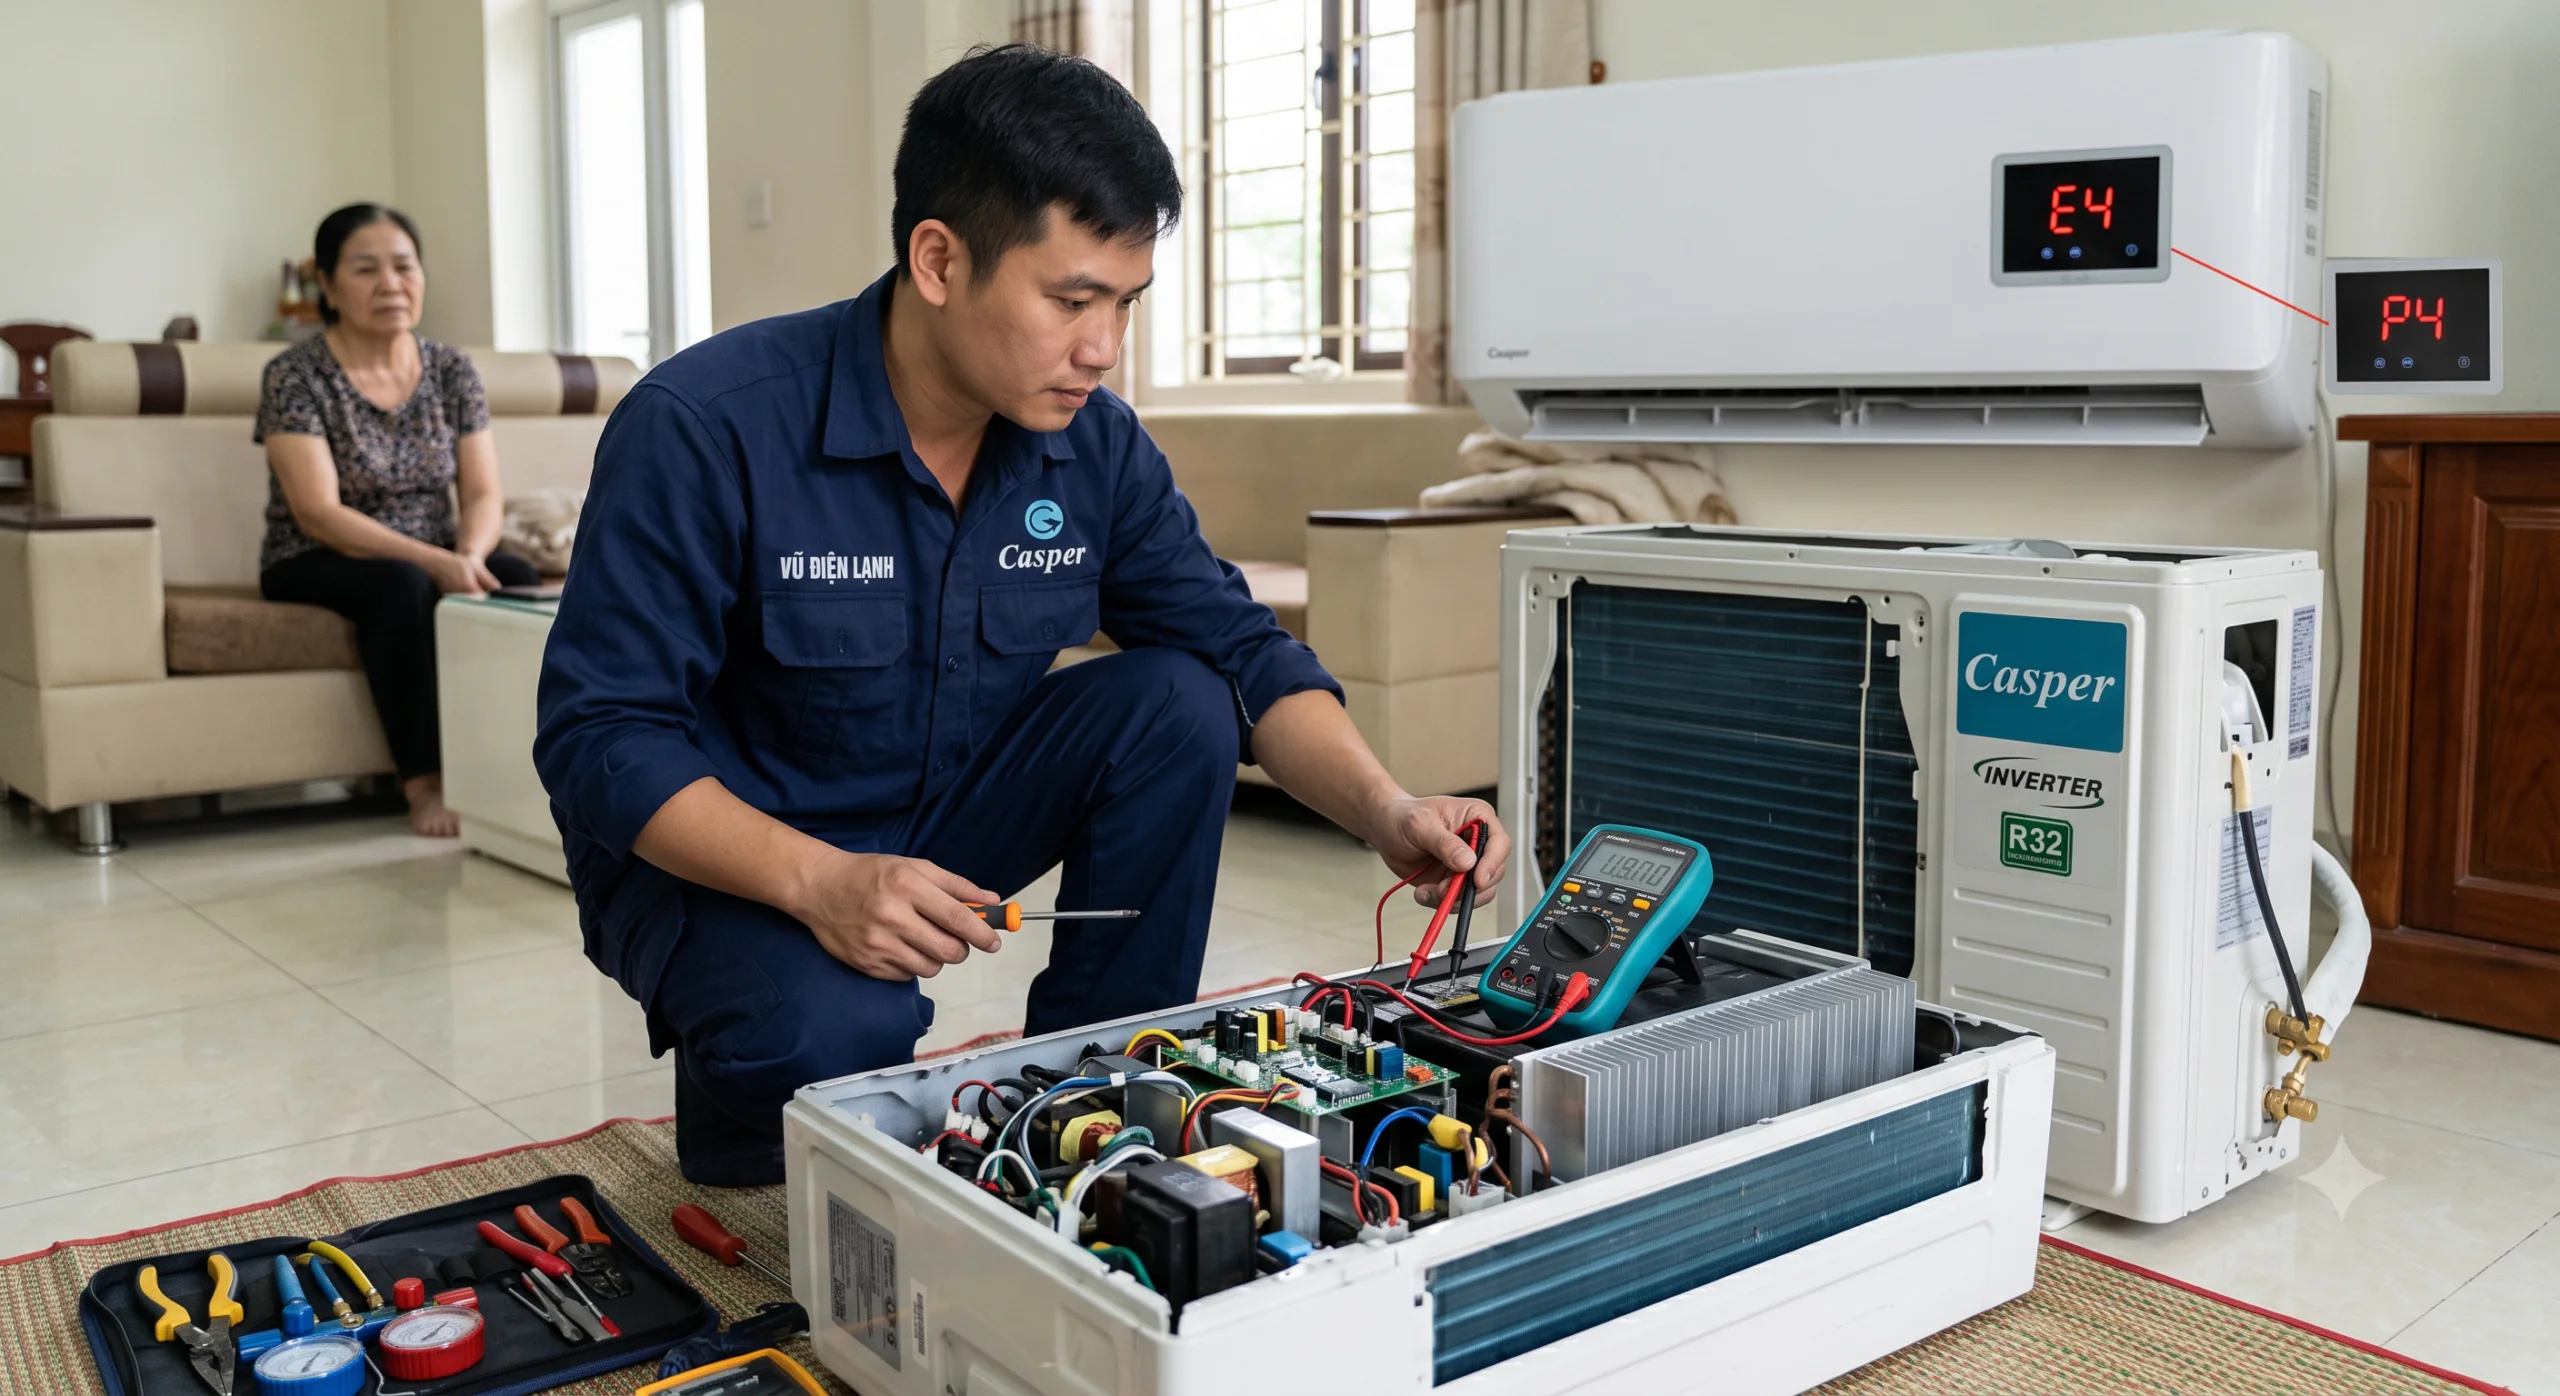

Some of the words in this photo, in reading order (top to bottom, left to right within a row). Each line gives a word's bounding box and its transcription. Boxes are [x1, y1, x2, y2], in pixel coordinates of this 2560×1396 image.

[2049, 184, 2114, 235] E4
[2381, 295, 2444, 342] P4
[780, 551, 804, 580] VŨ
[809, 551, 847, 585] ĐIỆN
[853, 556, 894, 584] LẠNH
[998, 544, 1086, 574] Casper
[1965, 653, 2116, 709] Casper
[1984, 766, 2103, 799] INVERTER
[2009, 823, 2063, 856] R32
